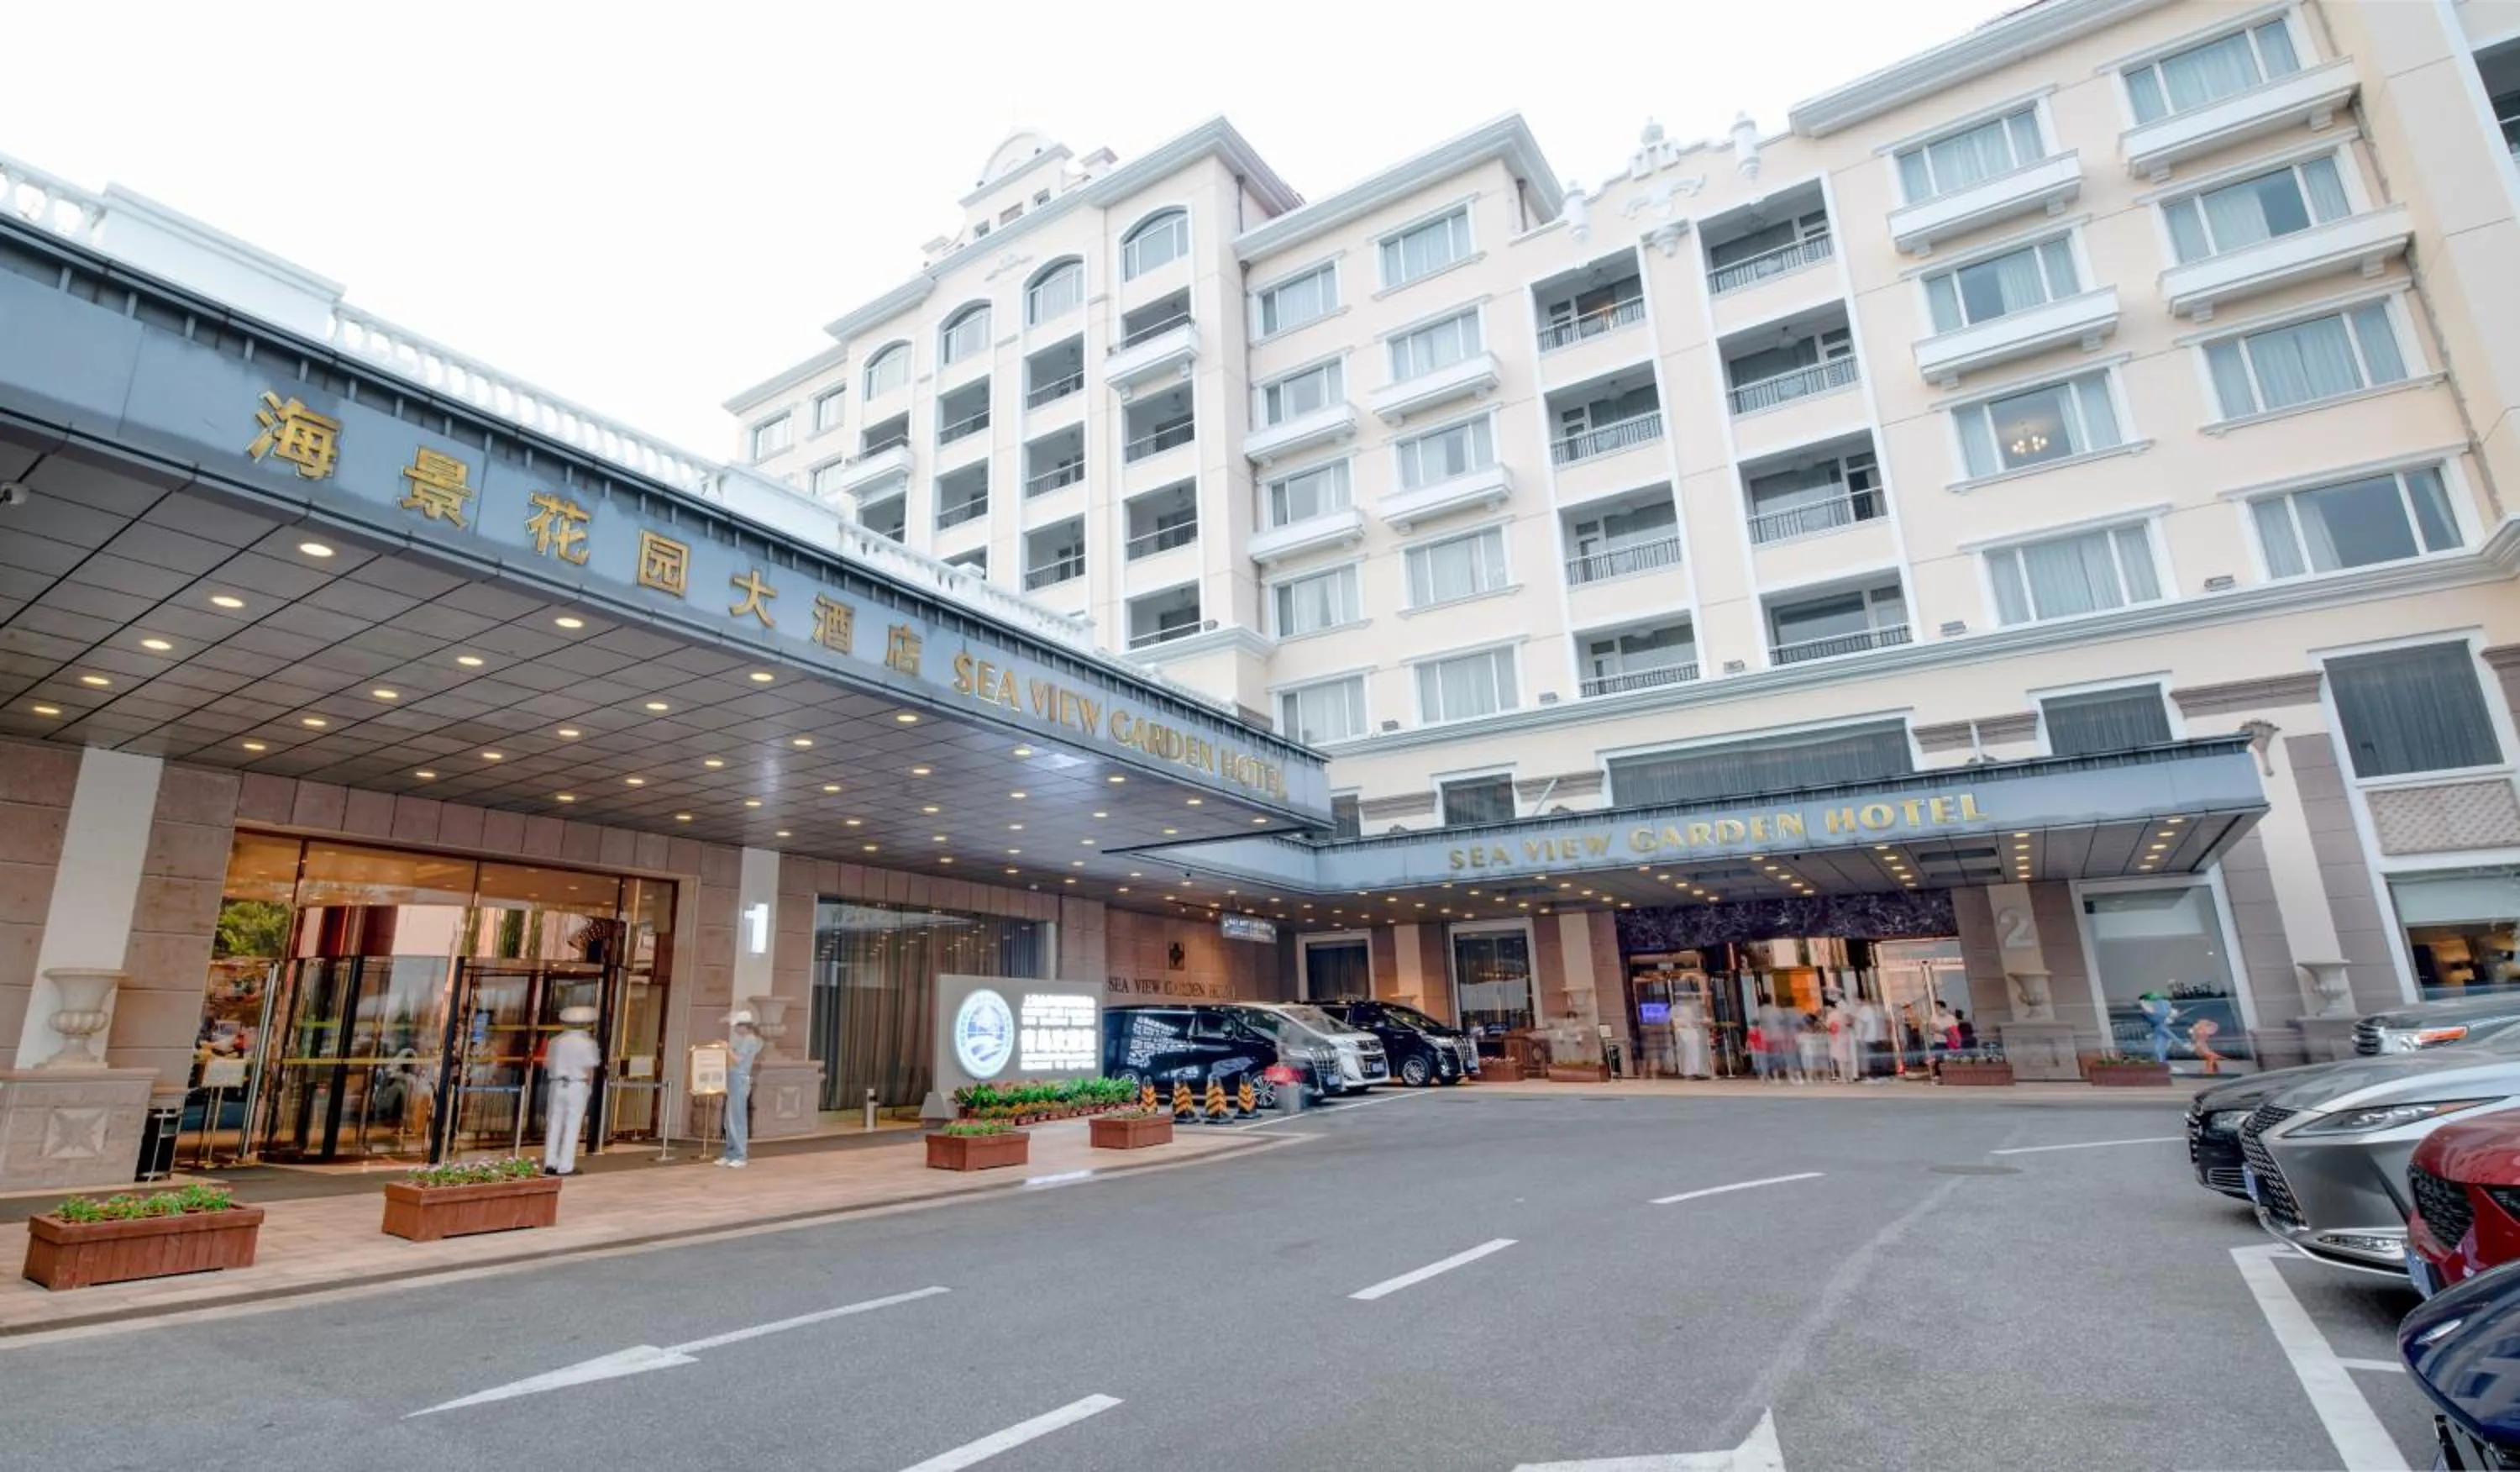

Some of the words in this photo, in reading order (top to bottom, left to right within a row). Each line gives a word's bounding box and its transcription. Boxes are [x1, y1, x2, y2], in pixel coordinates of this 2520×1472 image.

[245, 389, 922, 677] 海景花园大酒店
[953, 649, 1021, 713] SEA
[1029, 676, 1102, 736] VIEW
[1110, 709, 1215, 775] GARDEN
[1221, 746, 1288, 801] HOTEL
[1448, 843, 1512, 870] SEA
[1521, 832, 1613, 863] VIEW
[1627, 811, 1805, 854] GARDEN
[1824, 793, 1990, 835] HOTEL
[743, 902, 769, 954] 1
[1997, 907, 2039, 949] 2
[1108, 975, 1130, 994] SEA
[1135, 979, 1162, 996] VIEW
